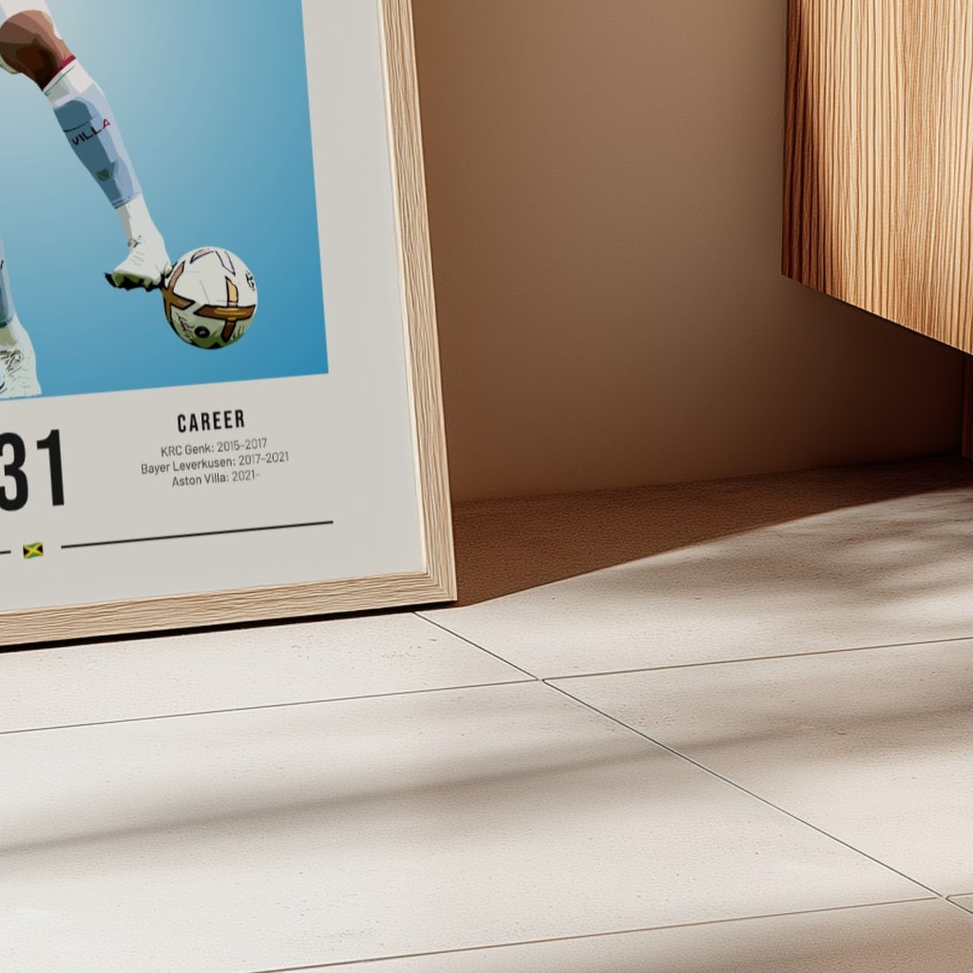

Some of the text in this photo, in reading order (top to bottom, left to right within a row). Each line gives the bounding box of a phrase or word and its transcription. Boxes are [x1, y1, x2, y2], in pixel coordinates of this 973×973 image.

[71, 118, 110, 145] VILLA
[177, 409, 245, 433] CAREER
[160, 437, 268, 457] KRC Genk: 2015-2017
[140, 450, 290, 476] Bayer Leverkusen: 2017-2021
[172, 475, 202, 487] Aston
[203, 472, 229, 484] Villa:
